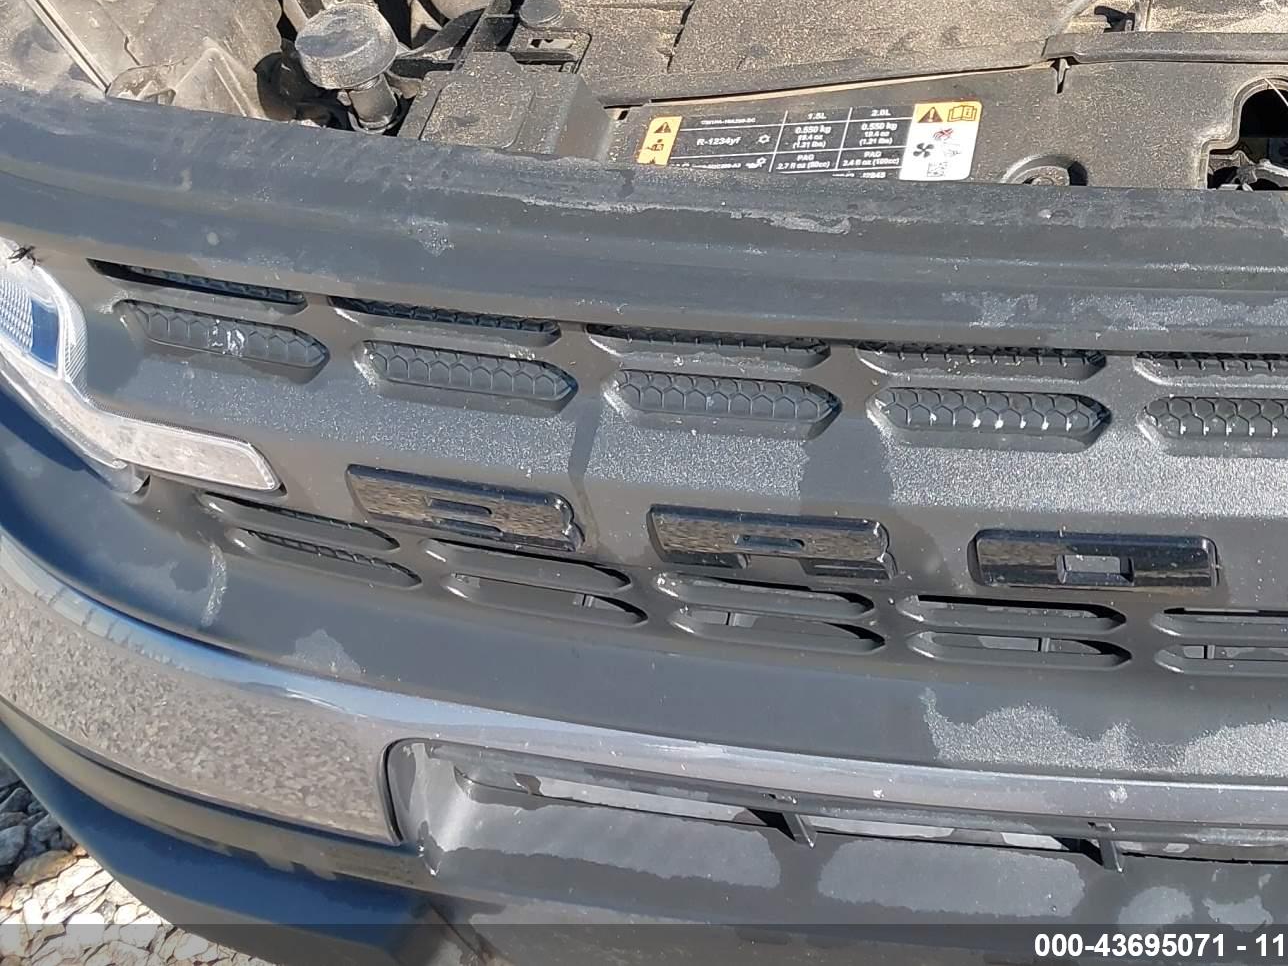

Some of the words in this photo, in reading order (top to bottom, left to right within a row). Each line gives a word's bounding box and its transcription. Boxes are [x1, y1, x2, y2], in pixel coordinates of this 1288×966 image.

[807, 112, 827, 121] 1.5L
[871, 109, 891, 117] 2.0L
[795, 126, 819, 134] 0.550
[819, 125, 832, 134] kg
[861, 122, 885, 131] 0.550
[886, 122, 898, 132] kg
[696, 136, 742, 146] R-1234yf
